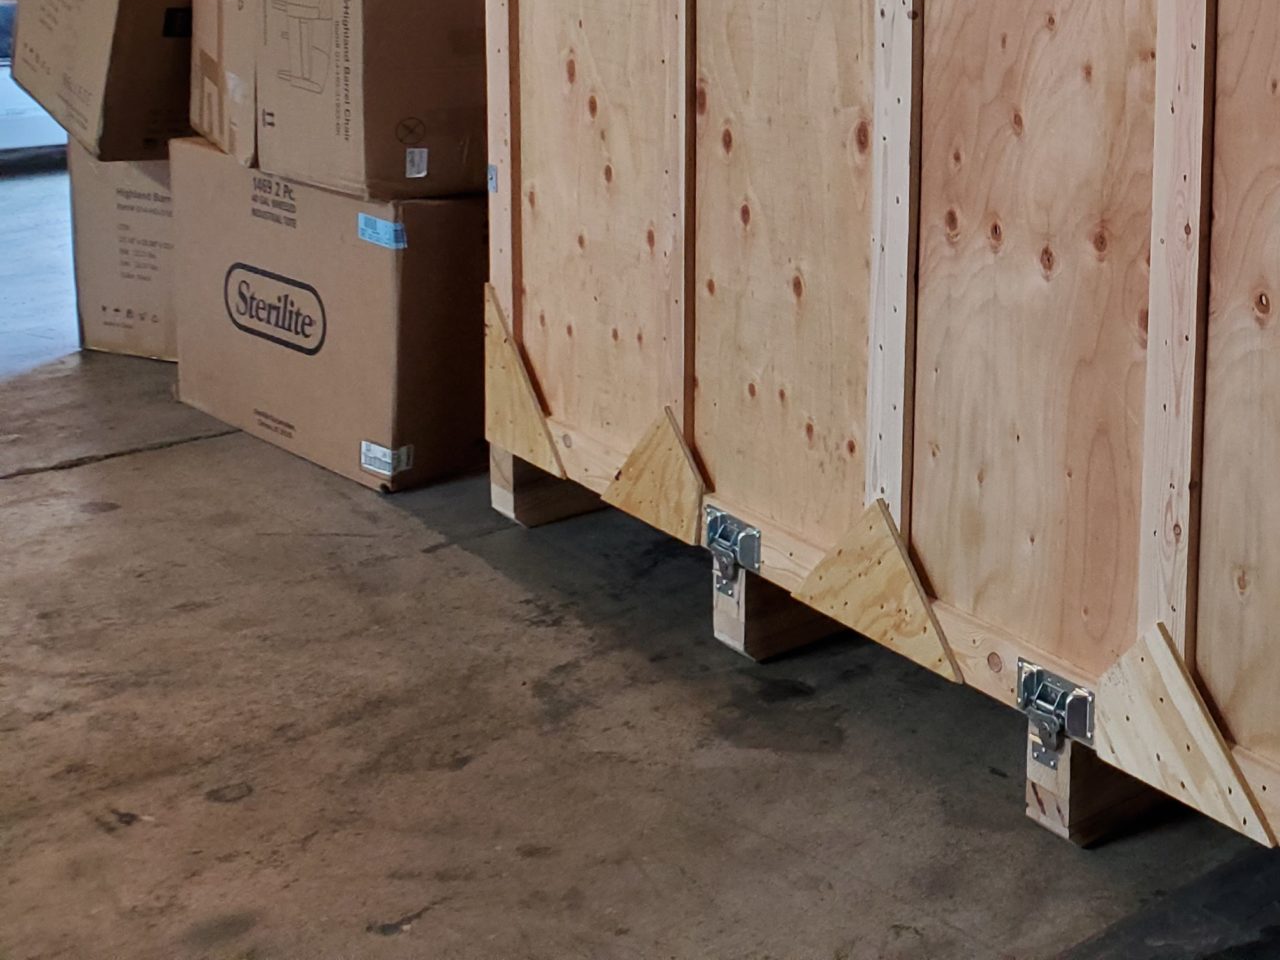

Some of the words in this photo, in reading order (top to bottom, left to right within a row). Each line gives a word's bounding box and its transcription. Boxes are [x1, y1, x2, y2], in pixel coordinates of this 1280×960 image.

[343, 66, 351, 105] Barrel
[275, 182, 280, 197] 2
[236, 280, 313, 338] Sterilite
